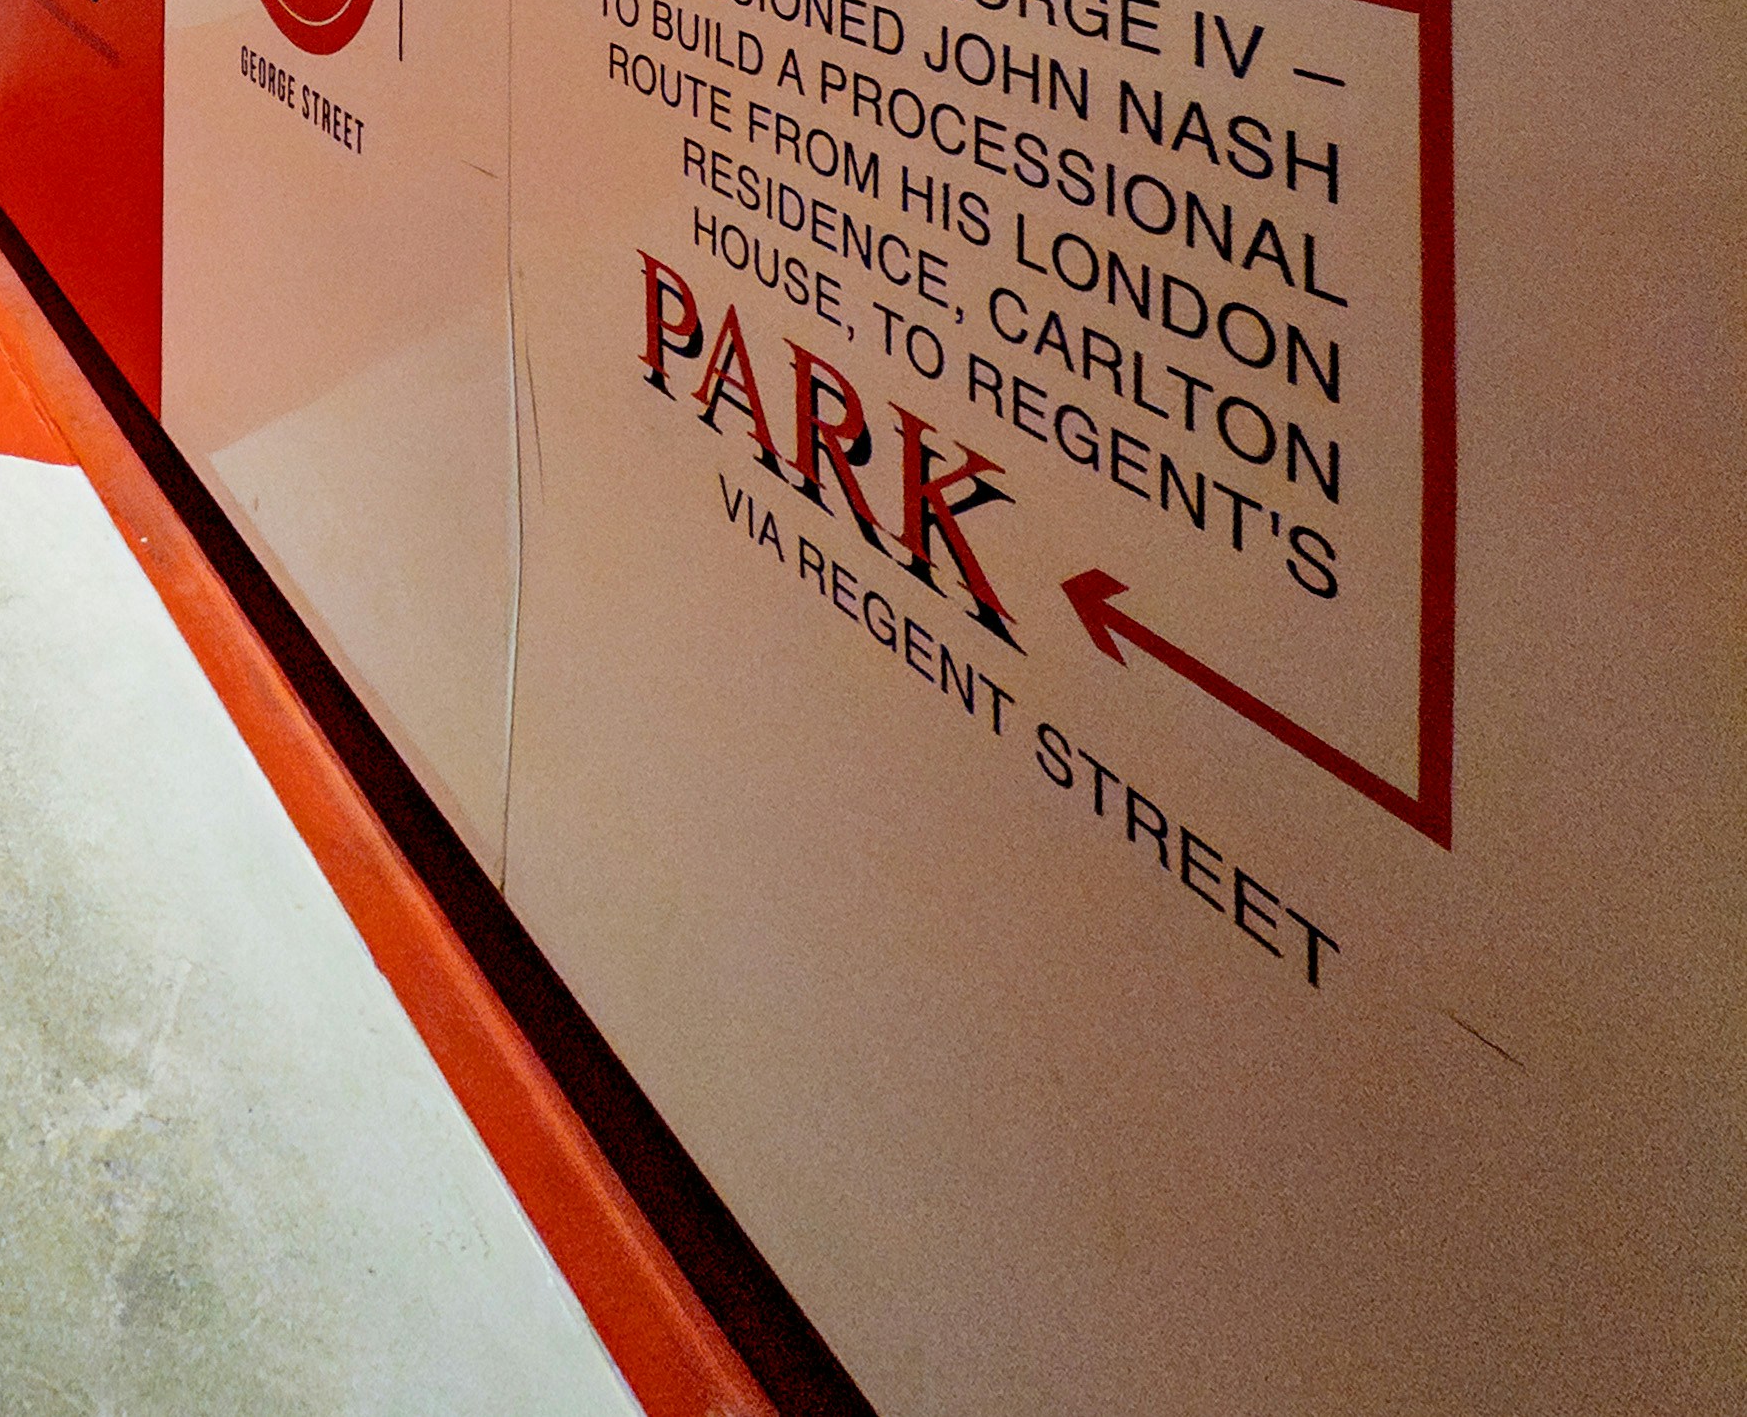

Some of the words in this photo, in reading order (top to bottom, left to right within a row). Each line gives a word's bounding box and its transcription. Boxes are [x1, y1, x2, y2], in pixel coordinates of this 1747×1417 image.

[240, 45, 296, 112] GEORGE
[300, 80, 365, 154] STREET
[610, 43, 732, 132] ROUTE
[748, 101, 879, 199] FROM
[902, 167, 991, 245] HIS
[1017, 214, 1341, 404] LONDON
[778, 48, 808, 95] A
[820, 60, 1348, 307] PROCESSIONAL
[924, 26, 1089, 121] JOHN
[1120, 80, 1341, 204] NASH
[1194, 11, 1264, 79] IV
[636, 249, 1027, 655] PARK
[683, 137, 965, 323] RESIDENCE,
[989, 287, 1341, 505] CARLTON
[694, 206, 855, 340] HOUSE,
[873, 302, 944, 381] TO
[968, 355, 1339, 599] REGENT'S
[719, 473, 785, 562] VIA
[799, 536, 1015, 735] REGENT
[1036, 723, 1340, 988] STREET
